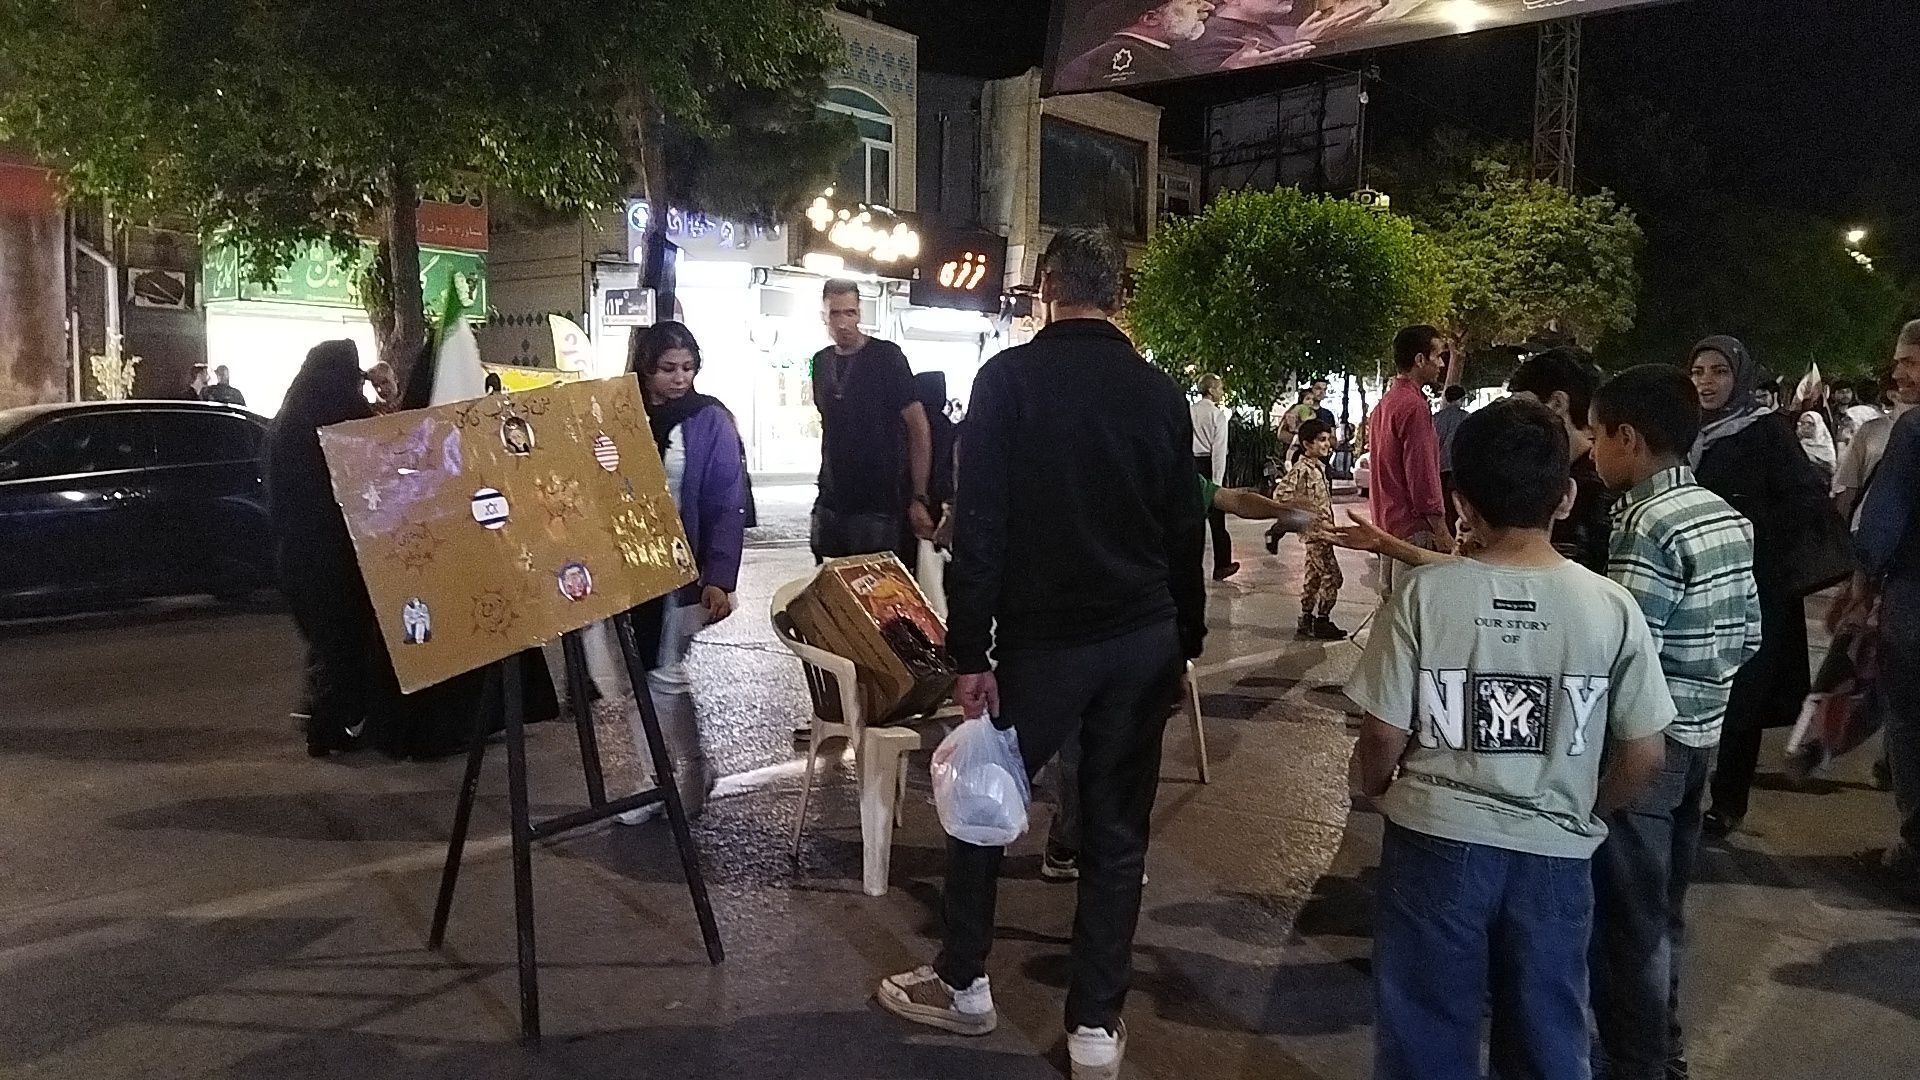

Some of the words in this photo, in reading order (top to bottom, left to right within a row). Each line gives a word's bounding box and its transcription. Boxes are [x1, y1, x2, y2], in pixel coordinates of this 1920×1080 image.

[1474, 617, 1503, 628] OUR
[1501, 634, 1521, 644] OF
[1419, 667, 1468, 750] N
[1561, 674, 1612, 756] Y
